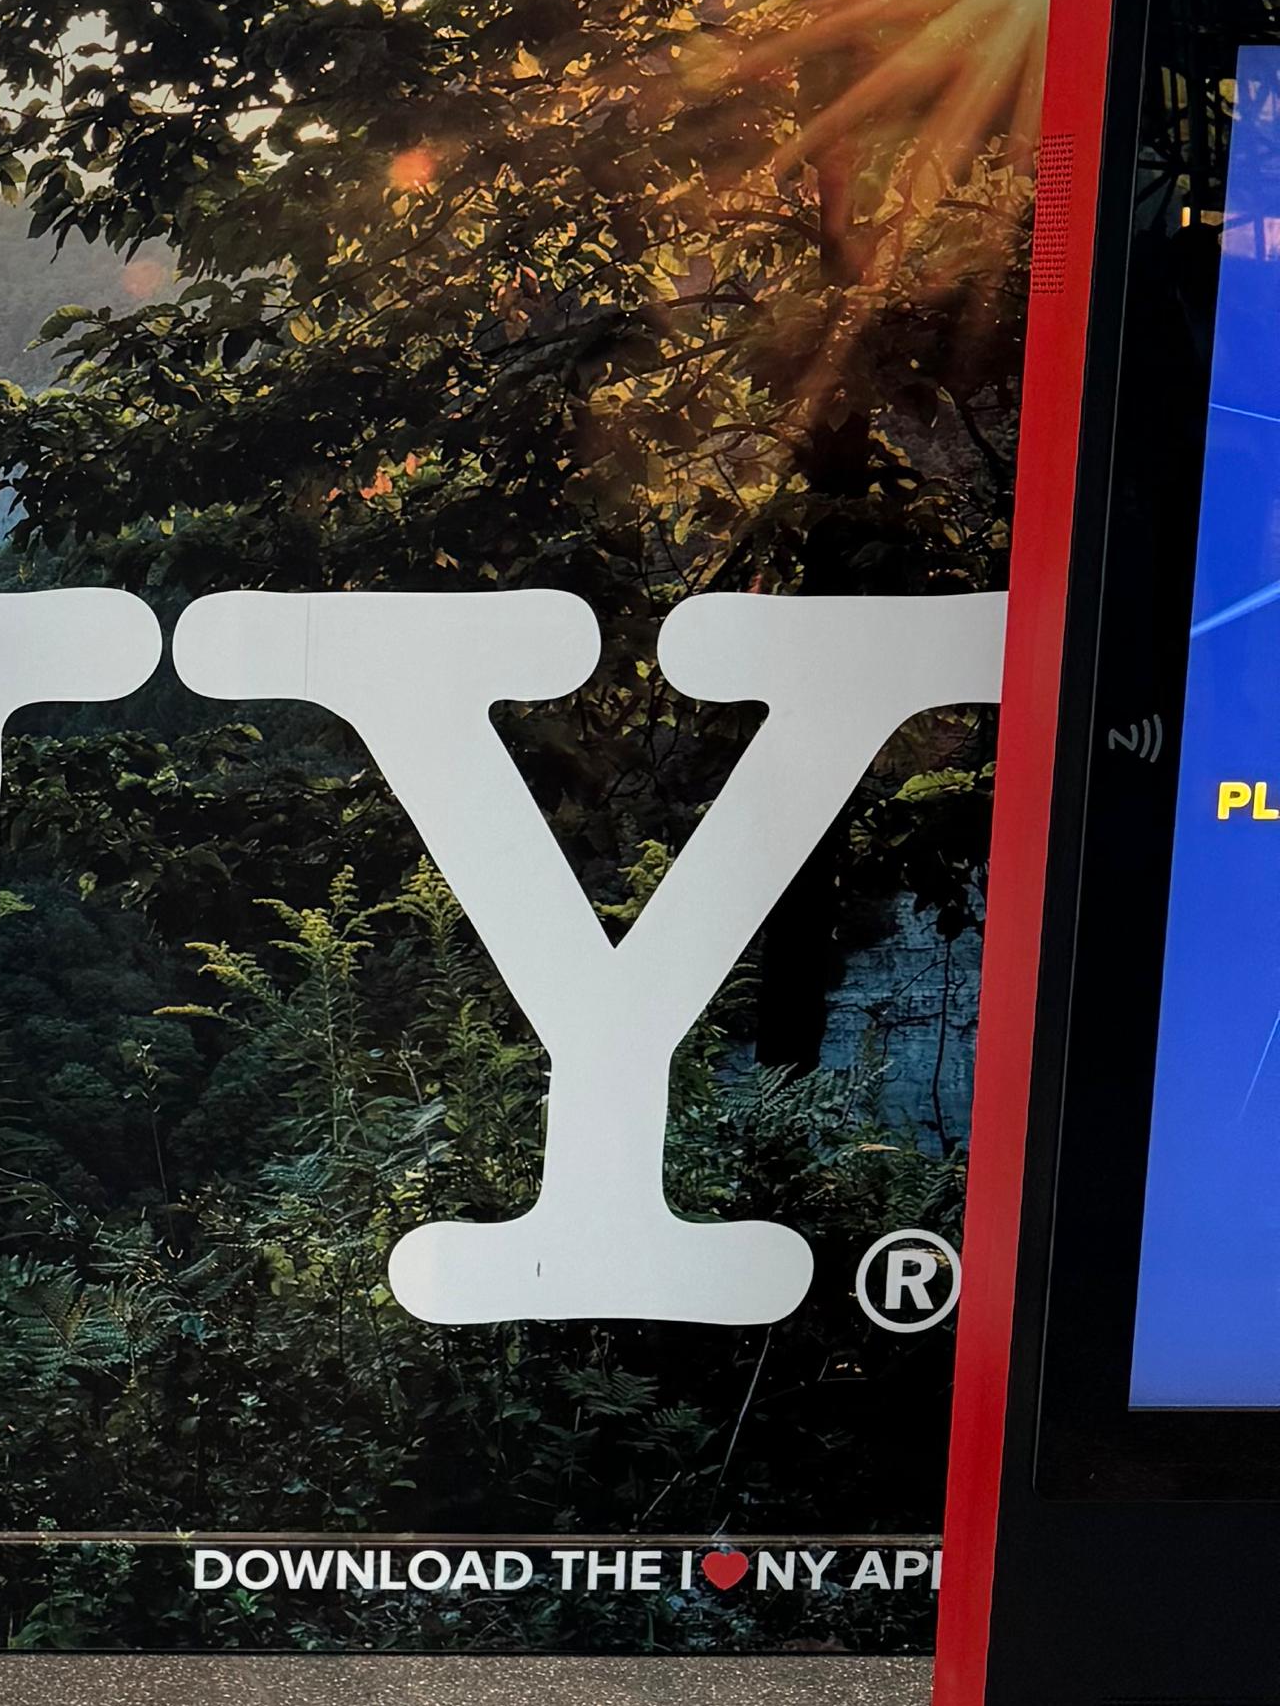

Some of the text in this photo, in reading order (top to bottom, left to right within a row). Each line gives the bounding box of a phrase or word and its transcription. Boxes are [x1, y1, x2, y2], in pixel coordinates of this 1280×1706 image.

[1217, 781, 1280, 820] PL
[193, 1549, 534, 1591] DOWNLOAD
[551, 1549, 662, 1591] THE
[756, 1550, 838, 1591] NY
